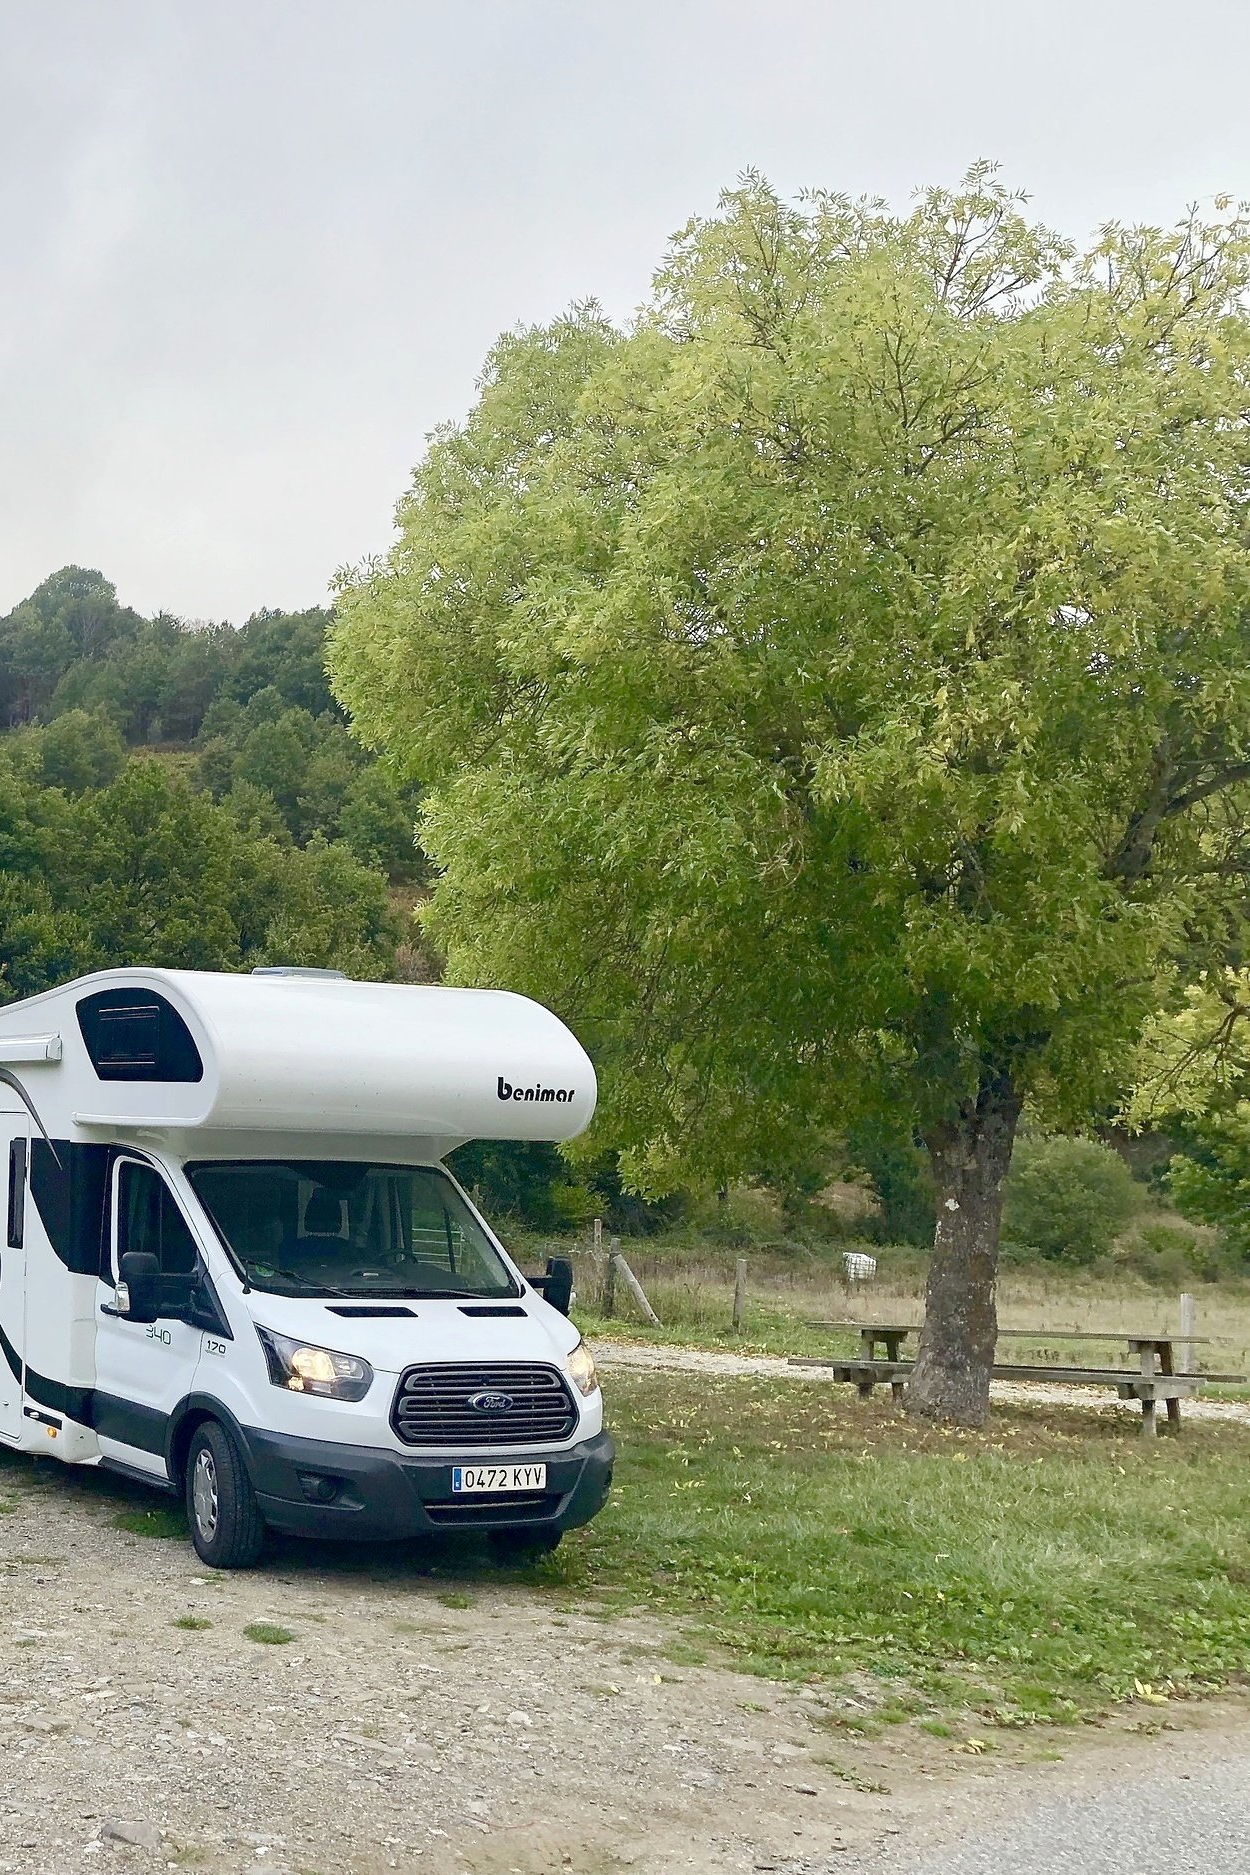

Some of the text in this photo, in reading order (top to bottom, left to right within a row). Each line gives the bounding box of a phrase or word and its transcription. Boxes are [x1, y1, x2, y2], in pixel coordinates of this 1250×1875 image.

[497, 1076, 575, 1103] benimar
[146, 1324, 171, 1345] 340
[207, 1340, 226, 1354] 170
[483, 1396, 506, 1408] Ford
[465, 1469, 507, 1488] 0472
[513, 1467, 542, 1486] KYV
